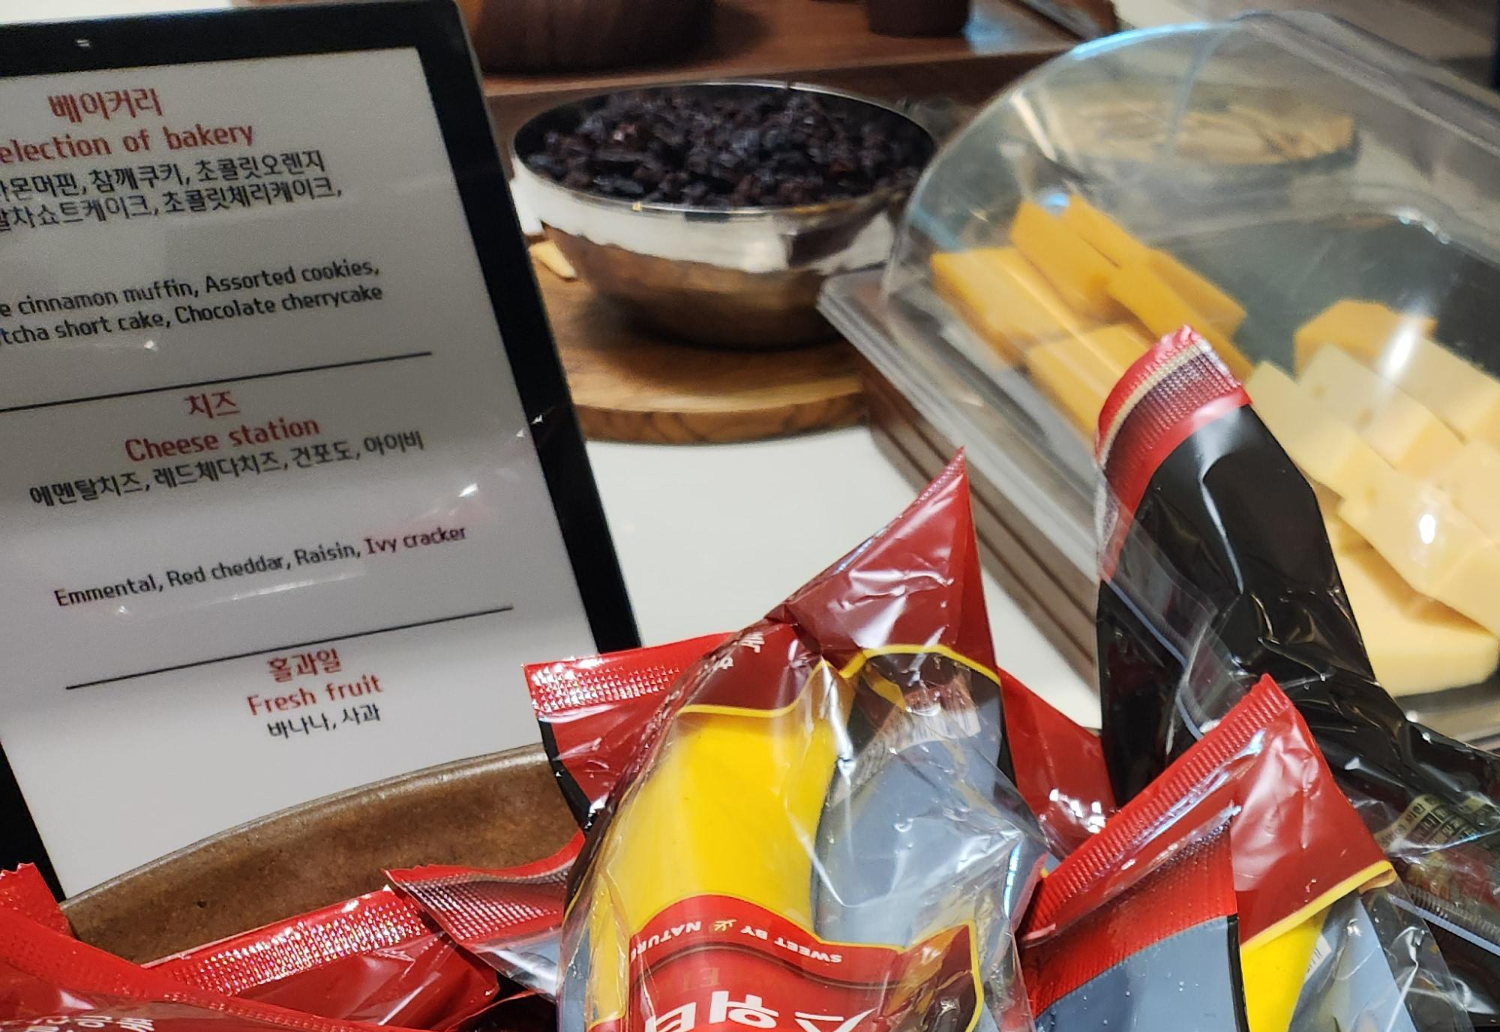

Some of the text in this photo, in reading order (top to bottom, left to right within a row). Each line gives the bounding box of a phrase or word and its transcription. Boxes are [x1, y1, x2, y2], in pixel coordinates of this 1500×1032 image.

[48, 87, 164, 123] 베이커리
[0, 123, 254, 164] election of bakery
[91, 163, 192, 194] 참깨쿠키,
[195, 150, 326, 184] 초콜릿오렌지
[163, 177, 343, 213] 초콜릿체리케이크,
[18, 291, 119, 315] cinnamon
[123, 278, 199, 303] muffin,
[205, 266, 296, 293] Assorted
[302, 258, 380, 284] cookies,
[55, 317, 112, 339] short
[118, 308, 171, 331] cake,
[176, 298, 276, 325] Chocolate
[282, 285, 383, 311] cherrycake
[185, 390, 241, 419] 치즈
[124, 416, 321, 463] Cheese station
[29, 430, 424, 508] 에멘탈치즈, 레드체다치즈, 건포도, 아이비
[55, 525, 467, 606] Emmental, Red cheddar, Raisin, Ivy cracker
[267, 648, 342, 684] 홀과일
[247, 674, 384, 717] Fresh fruit
[267, 703, 381, 741] 바나나, 사과
[740, 925, 768, 941] BY
[774, 936, 843, 964] SWEET
